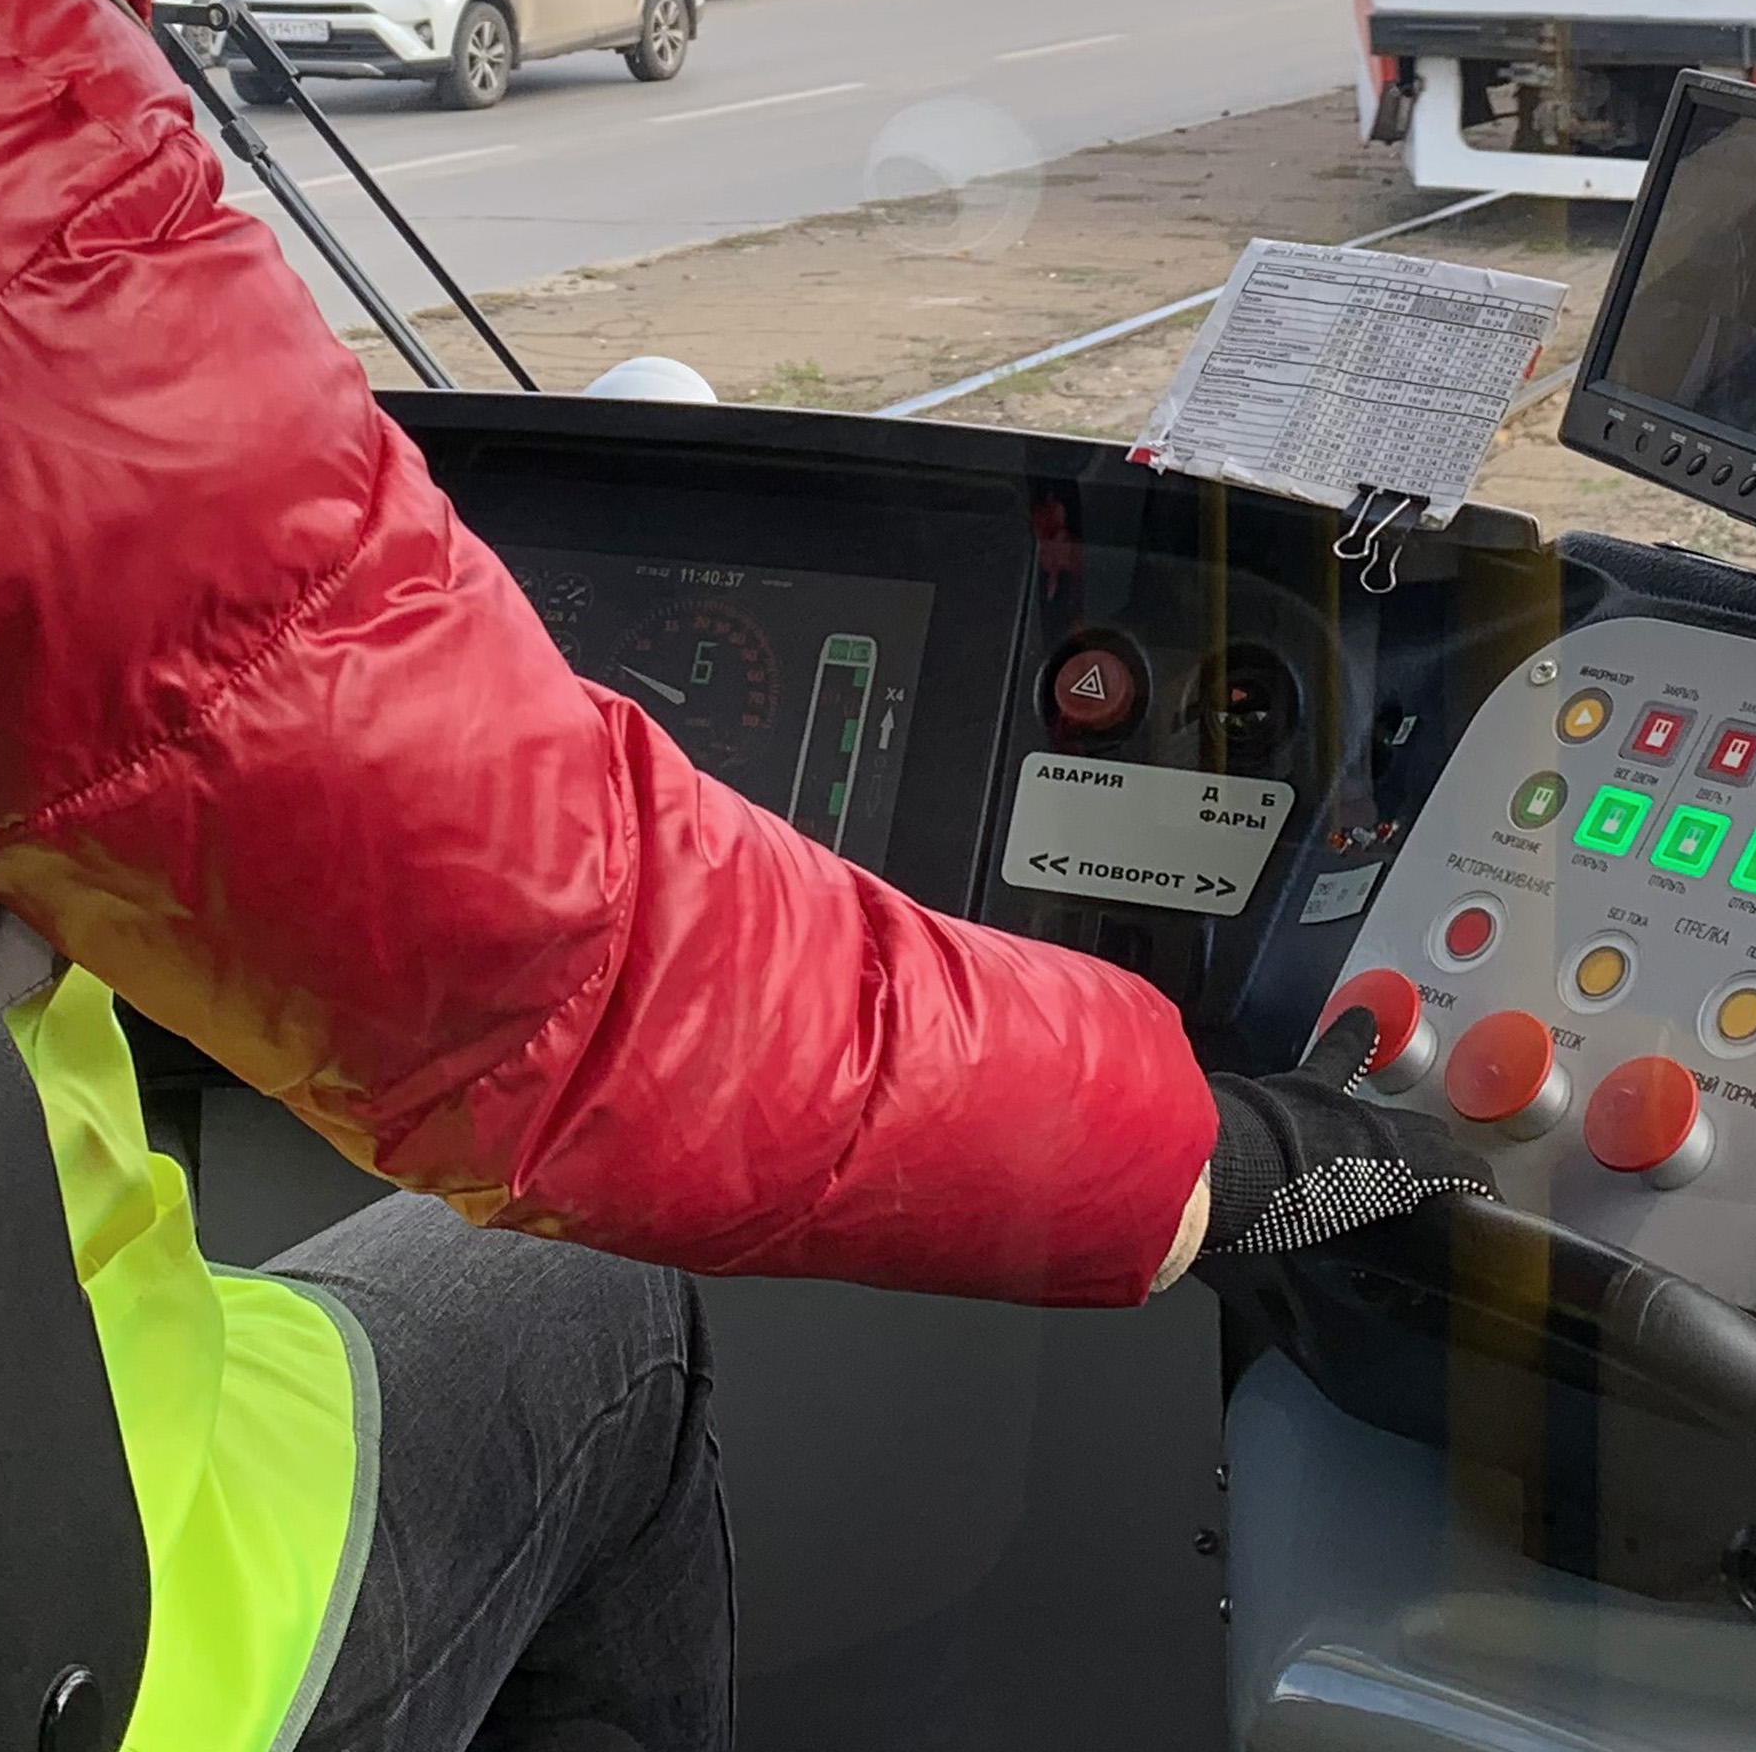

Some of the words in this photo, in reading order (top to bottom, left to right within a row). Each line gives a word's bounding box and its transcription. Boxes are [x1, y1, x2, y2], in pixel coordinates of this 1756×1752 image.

[680, 567, 744, 588] 11:40:37
[691, 641, 718, 685] 6
[885, 686, 905, 702] X4
[1036, 765, 1124, 789] АВАРИЯ
[1202, 786, 1219, 803] Д
[1260, 793, 1276, 808] Б
[1199, 809, 1267, 830] ФАРЫ
[1078, 861, 1186, 889] ПОВОРОТ
[1445, 853, 1556, 897] РАСТОРМАЖИВАНИЕ
[1628, 910, 1650, 928] ТОКА
[1674, 916, 1732, 947] СТРЕЛКА
